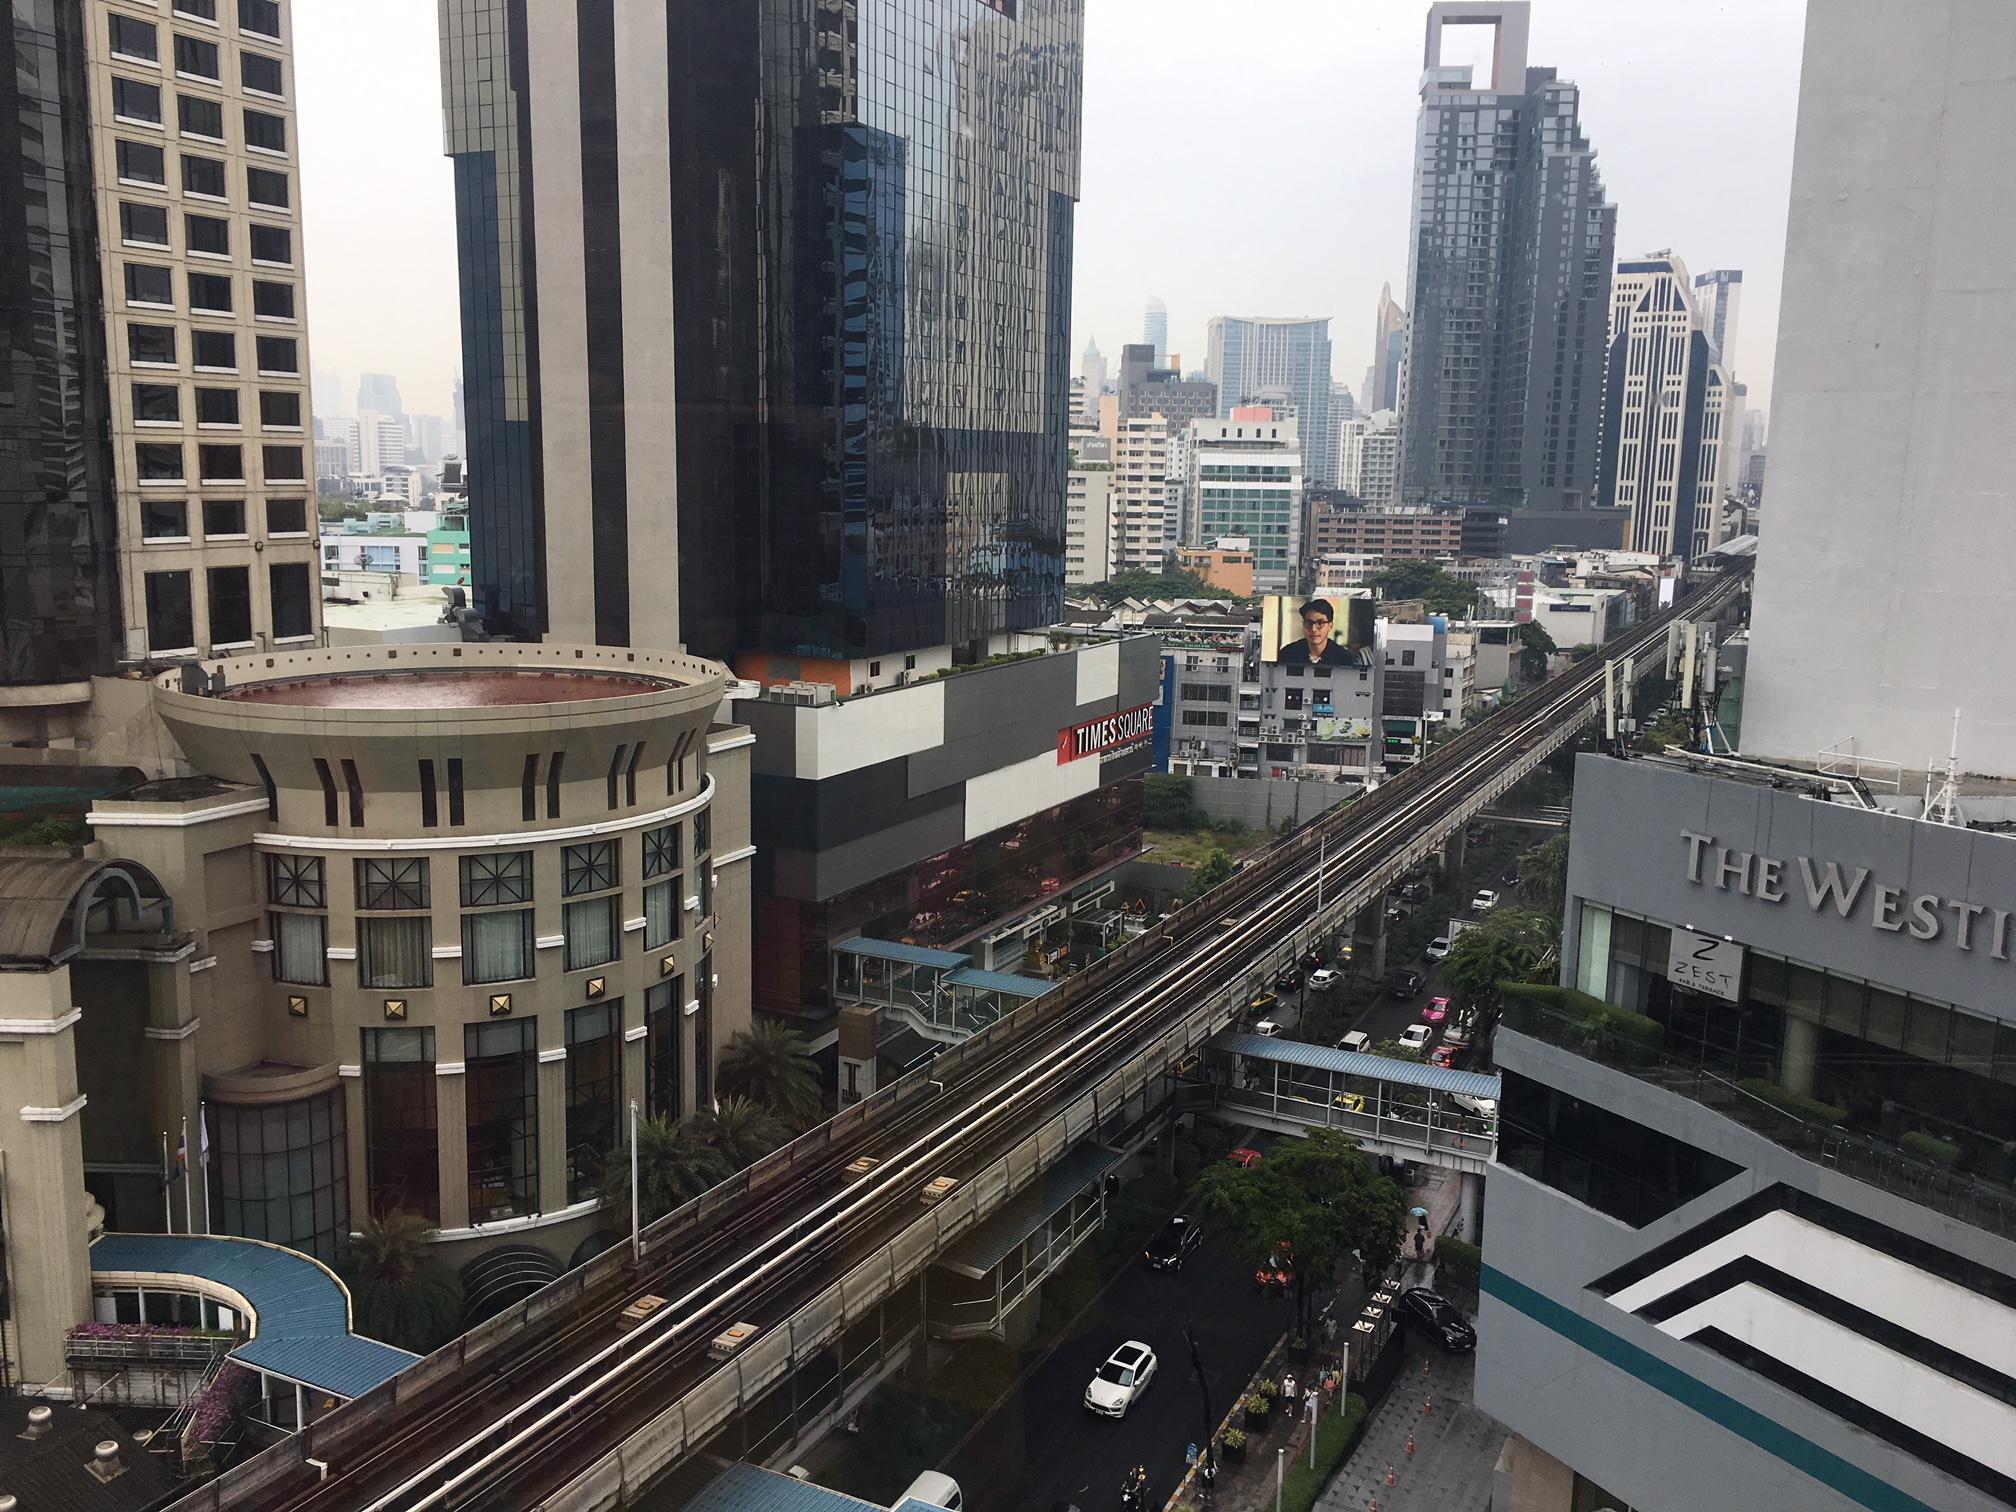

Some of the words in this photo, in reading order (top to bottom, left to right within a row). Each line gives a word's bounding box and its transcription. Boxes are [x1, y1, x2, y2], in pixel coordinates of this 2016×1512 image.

[1077, 718, 1116, 754] TIMES
[1117, 706, 1154, 741] SQUARE
[1680, 829, 1787, 903] THE
[1692, 939, 1719, 960] Z
[1674, 961, 1734, 989] ZEST
[1698, 983, 1725, 996] TERRACE
